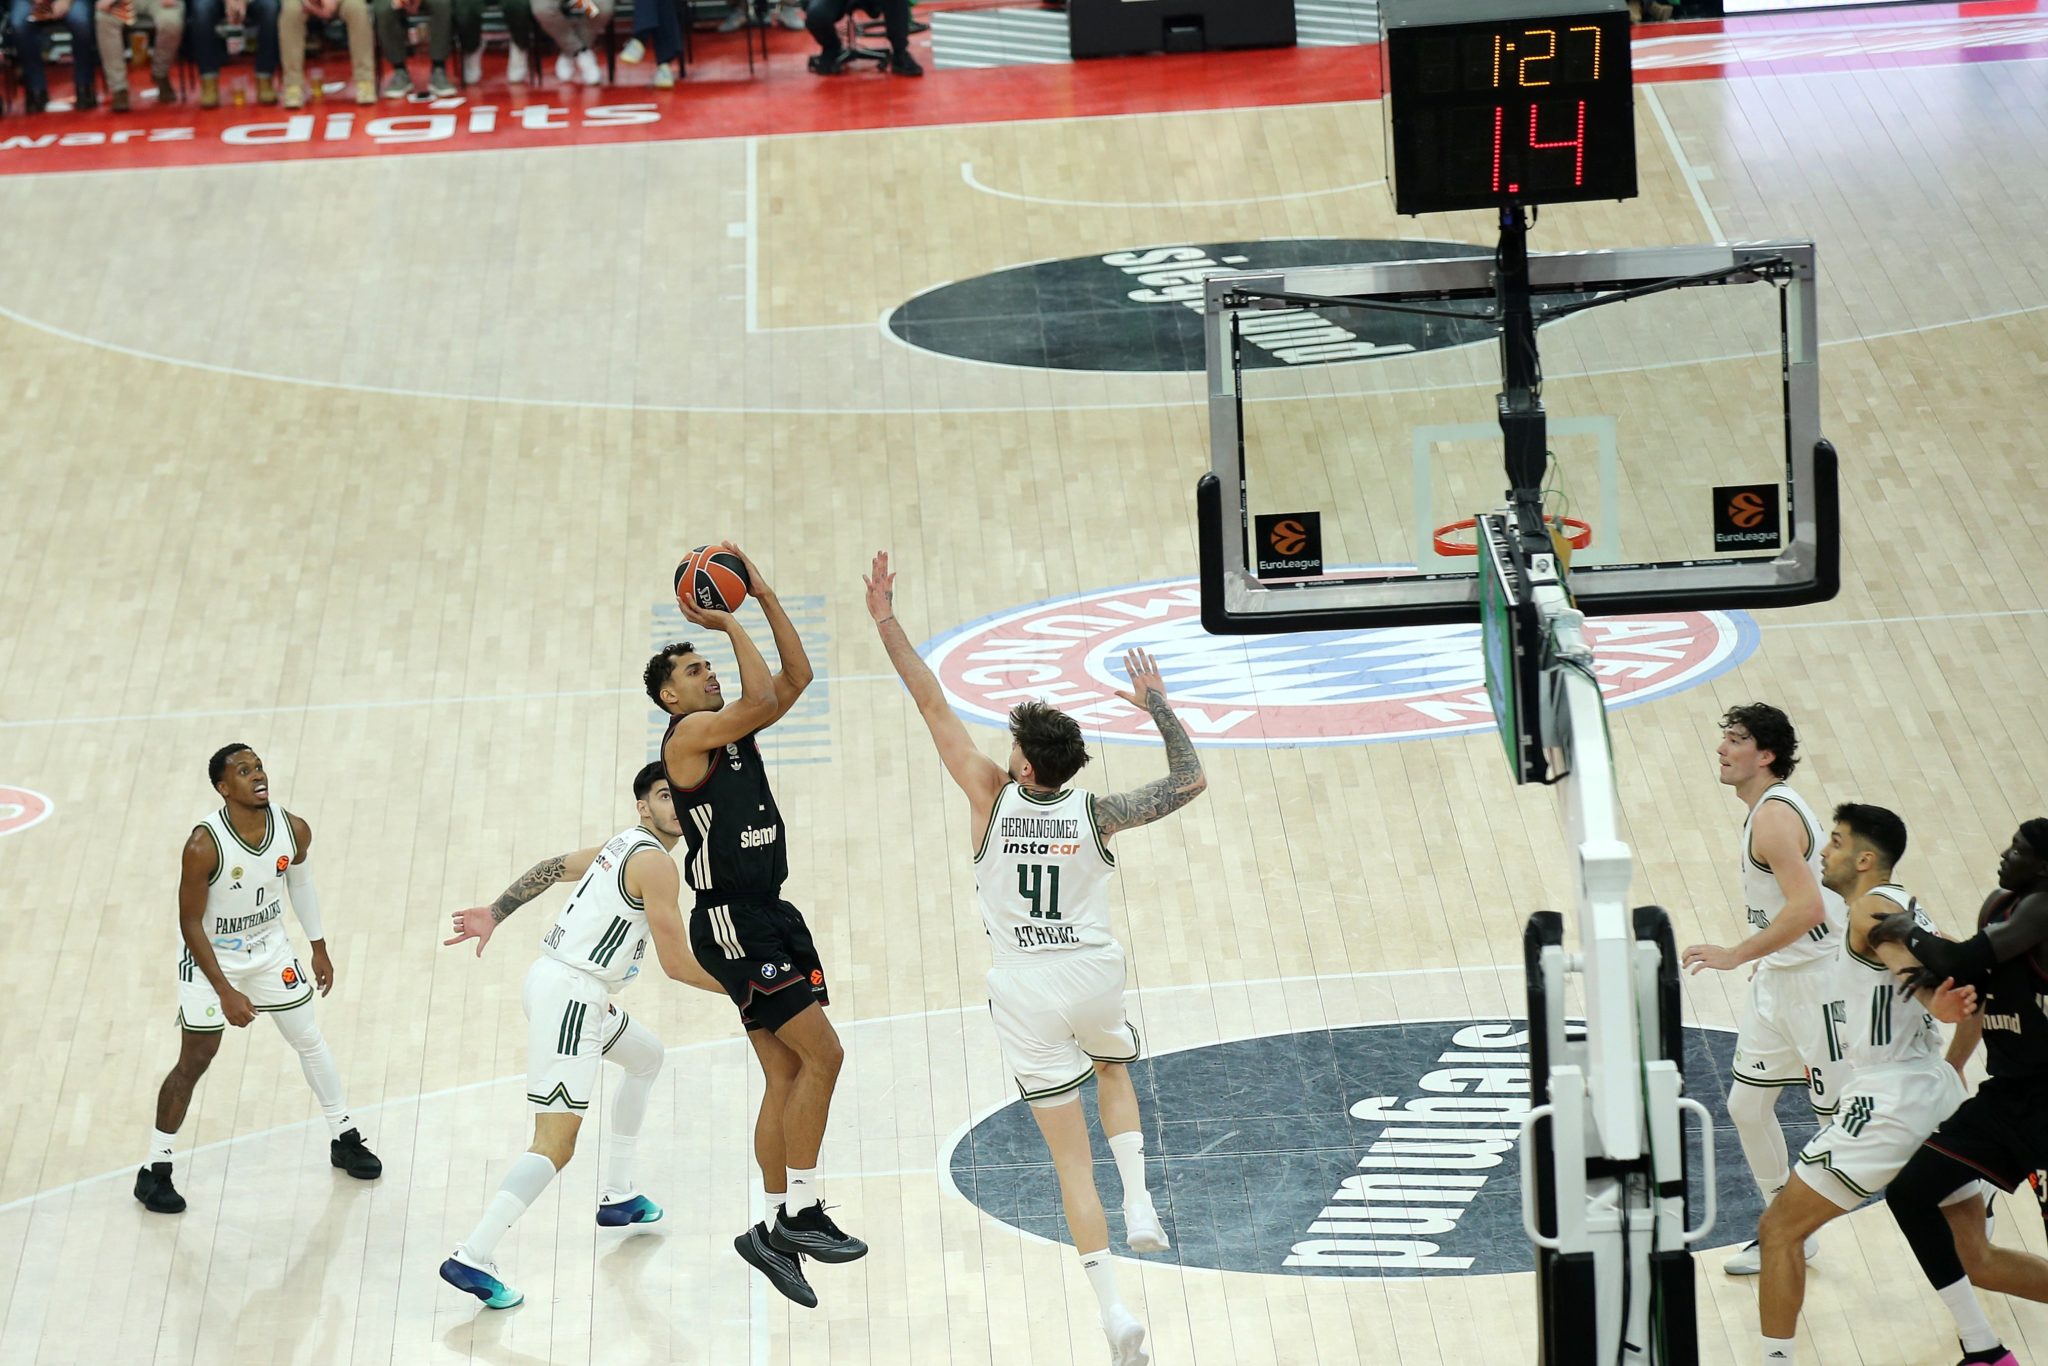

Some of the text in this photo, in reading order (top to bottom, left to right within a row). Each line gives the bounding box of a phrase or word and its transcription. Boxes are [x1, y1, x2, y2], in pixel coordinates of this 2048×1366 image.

[220, 103, 662, 144] digits
[1492, 101, 1586, 192] 1.4
[1716, 532, 1778, 542] EuroLeague
[1259, 559, 1320, 570] EuroLeague
[1001, 817, 1078, 839] HERNANGOMEZ
[1003, 839, 1080, 855] instacar
[256, 887, 264, 907] 0
[1017, 864, 1062, 920] 41
[1811, 1067, 1824, 1096] 6
